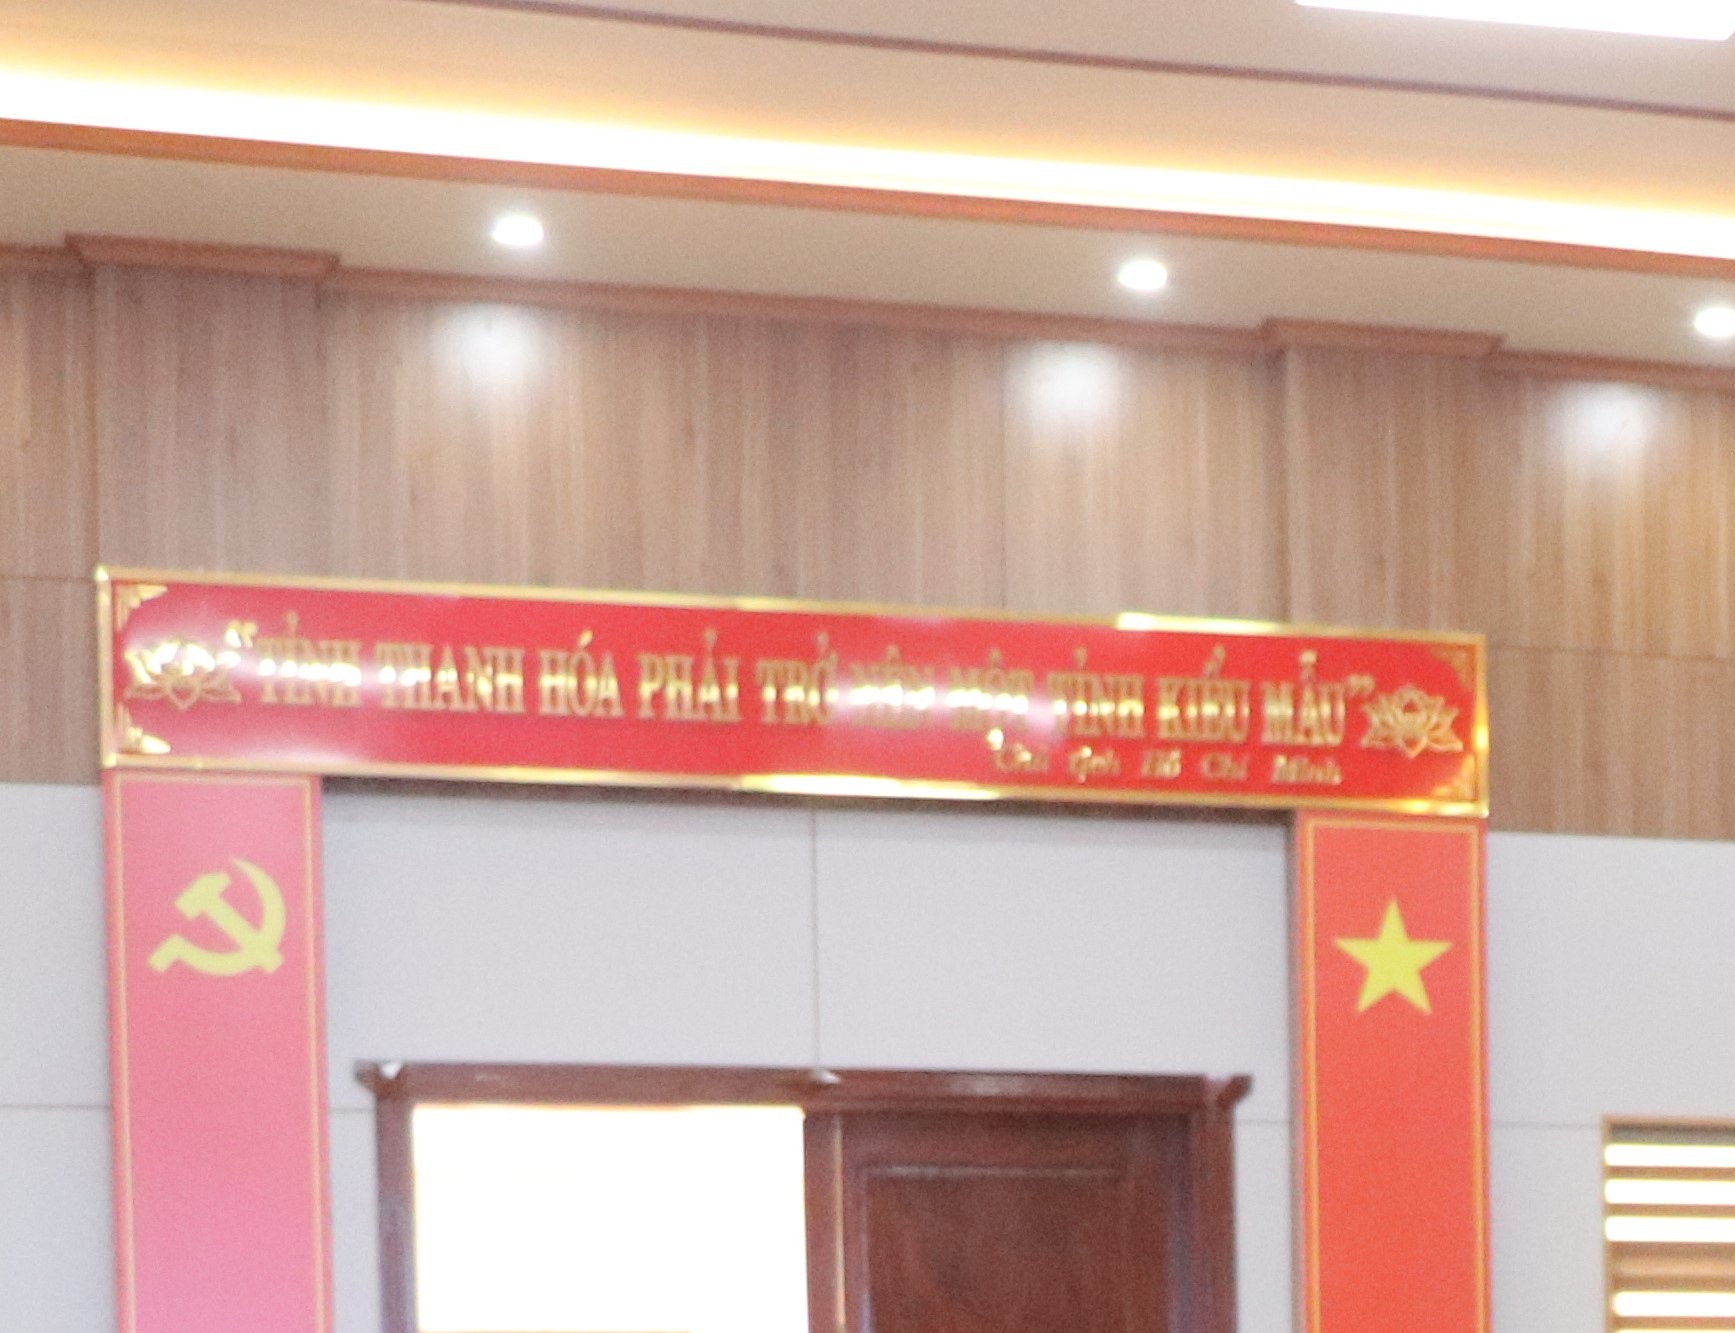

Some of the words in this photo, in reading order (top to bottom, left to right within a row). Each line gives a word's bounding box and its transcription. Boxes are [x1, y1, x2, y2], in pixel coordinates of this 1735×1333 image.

[375, 640, 525, 714] THANH
[539, 629, 624, 718] HÓA
[636, 628, 741, 723] PHẢI
[755, 631, 839, 727] TRỞ
[1047, 645, 1144, 739] TỈNH
[1157, 645, 1250, 743] KIỂU
[1271, 753, 1342, 785] Minh
